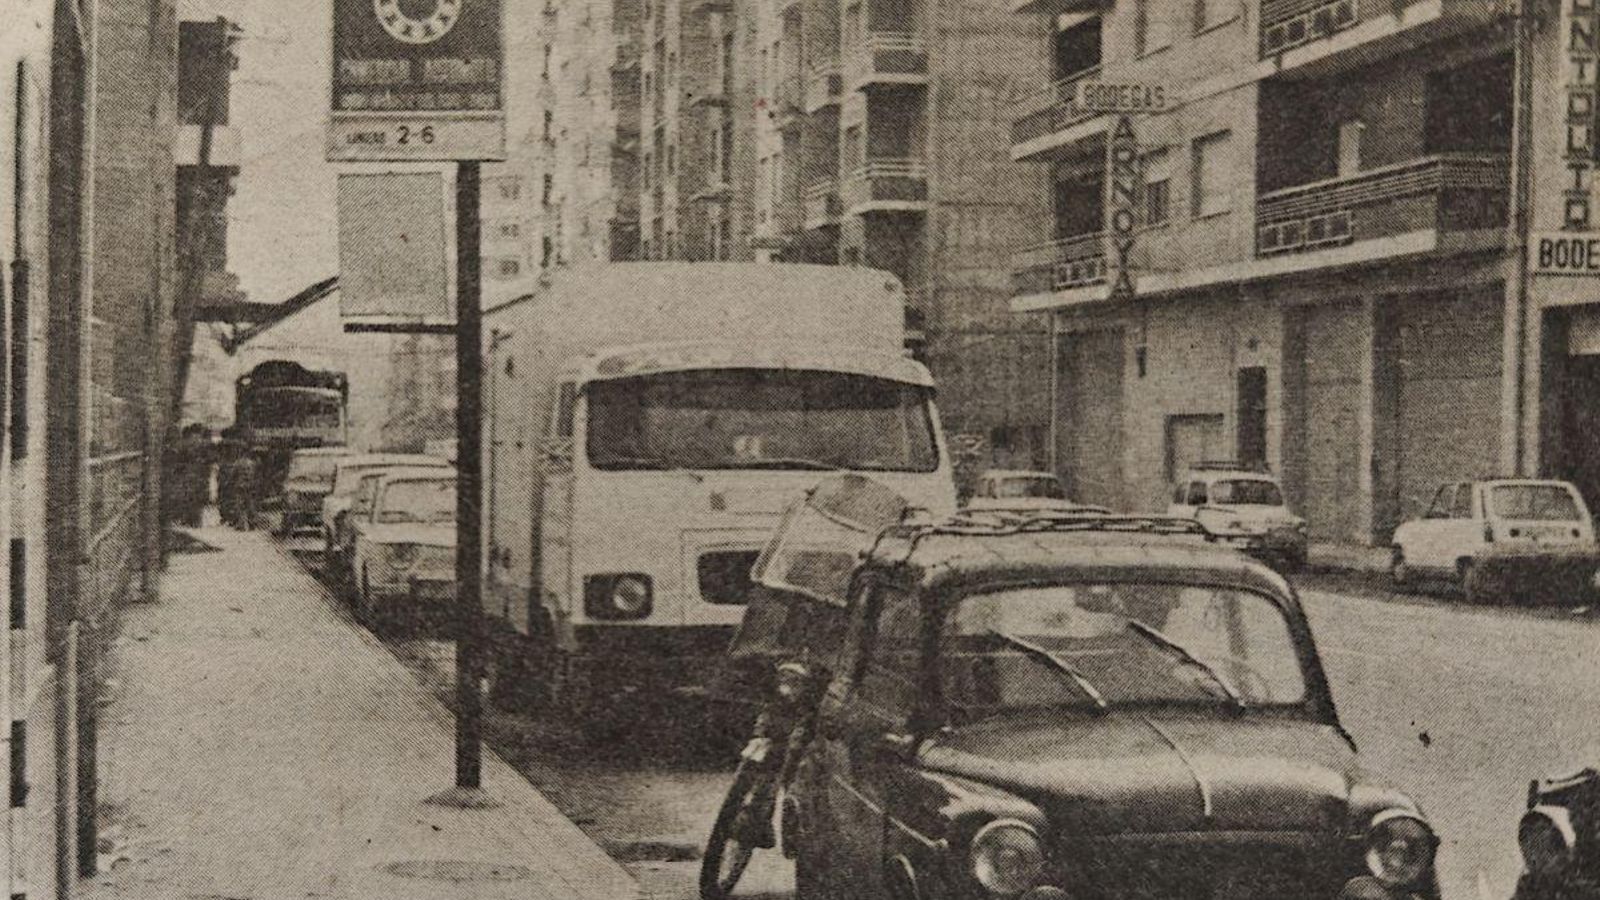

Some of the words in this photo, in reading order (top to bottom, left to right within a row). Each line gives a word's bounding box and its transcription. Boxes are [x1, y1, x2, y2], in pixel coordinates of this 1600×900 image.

[1084, 84, 1165, 109] BODEGAS
[1111, 115, 1137, 297] ARNOYA
[1539, 237, 1600, 269] BODE
